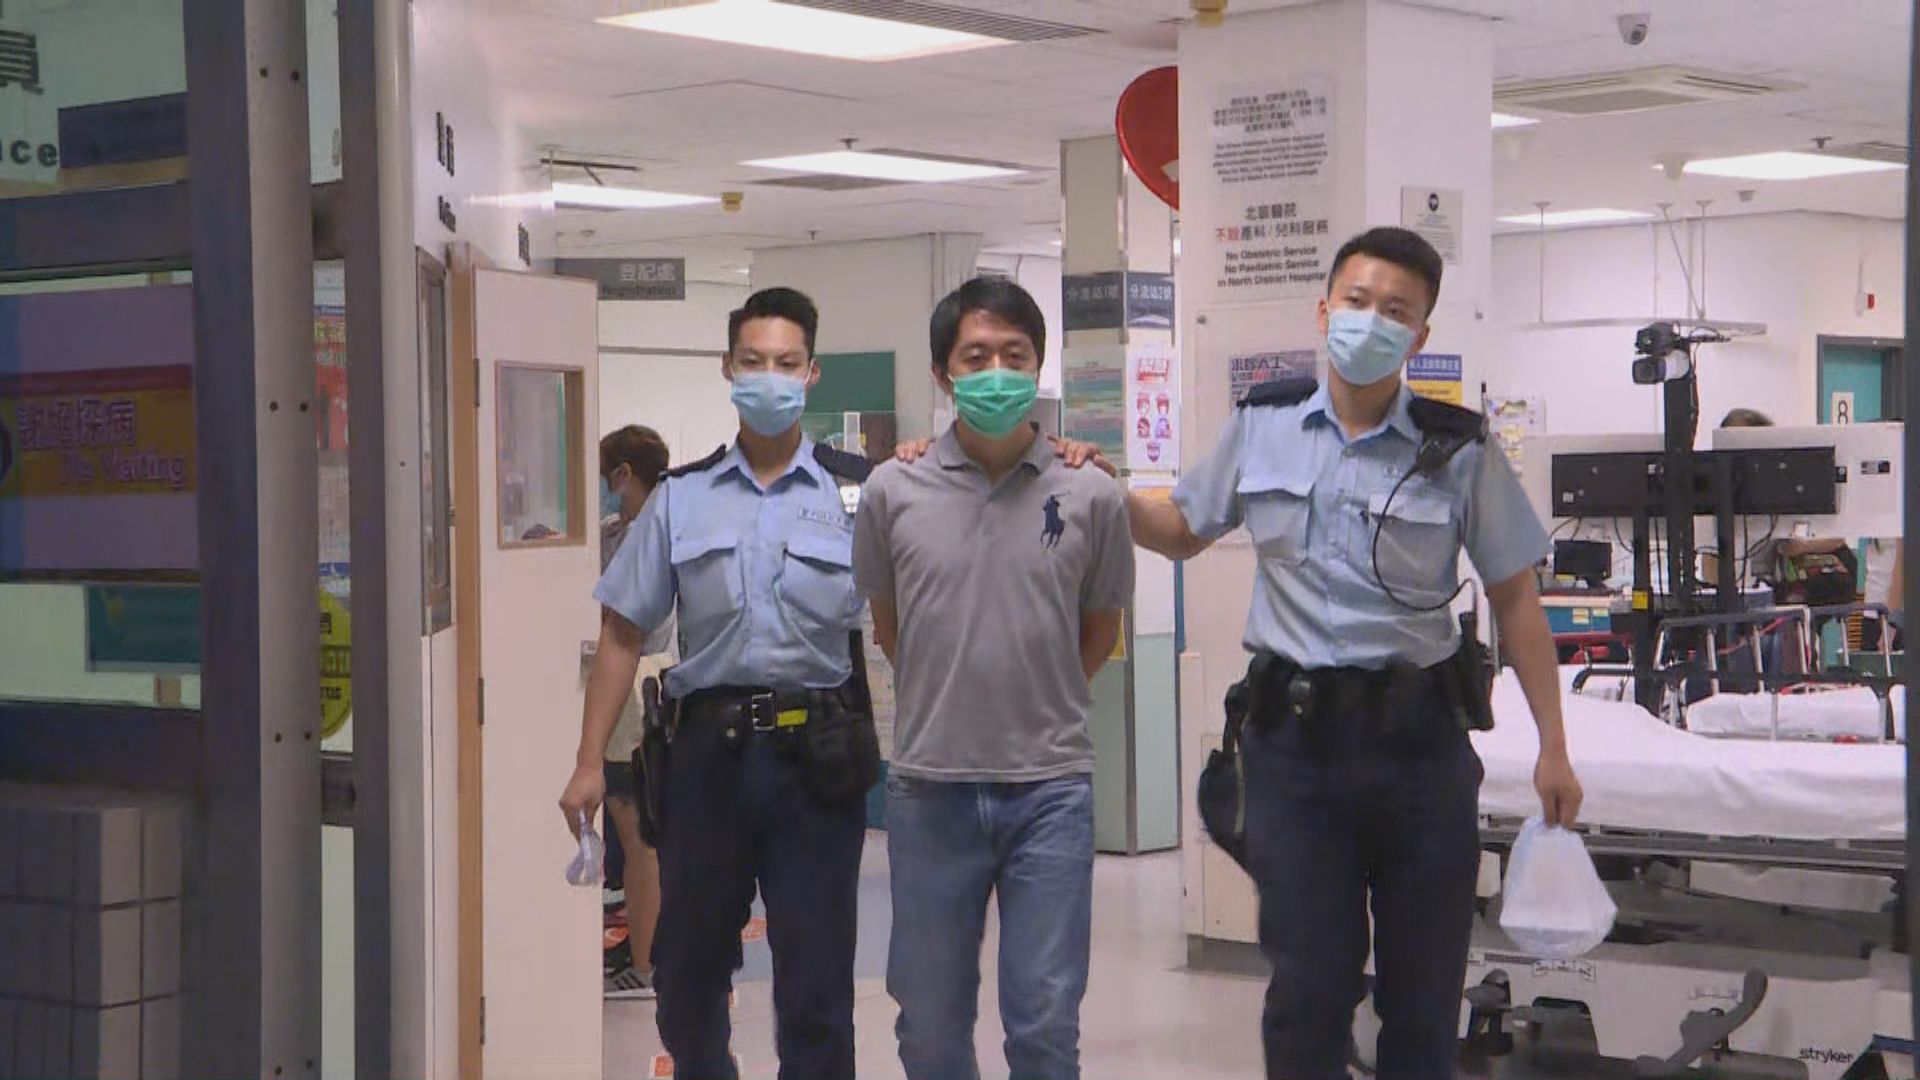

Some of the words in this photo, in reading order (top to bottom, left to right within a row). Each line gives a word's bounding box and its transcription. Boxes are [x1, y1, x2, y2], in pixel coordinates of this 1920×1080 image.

[0, 138, 58, 167] ce
[1226, 251, 1238, 261] No
[1240, 249, 1281, 259] Obstetric
[1283, 246, 1317, 257] Service
[1225, 264, 1237, 274] No
[1239, 261, 1283, 272] Paediatric
[1285, 259, 1319, 270] Service
[1228, 277, 1253, 287] North
[1254, 273, 1287, 285] District
[1289, 271, 1327, 283] Hospital
[1837, 399, 1849, 425] 8
[101, 447, 186, 489] Visiting
[1799, 1046, 1854, 1064] stryker
